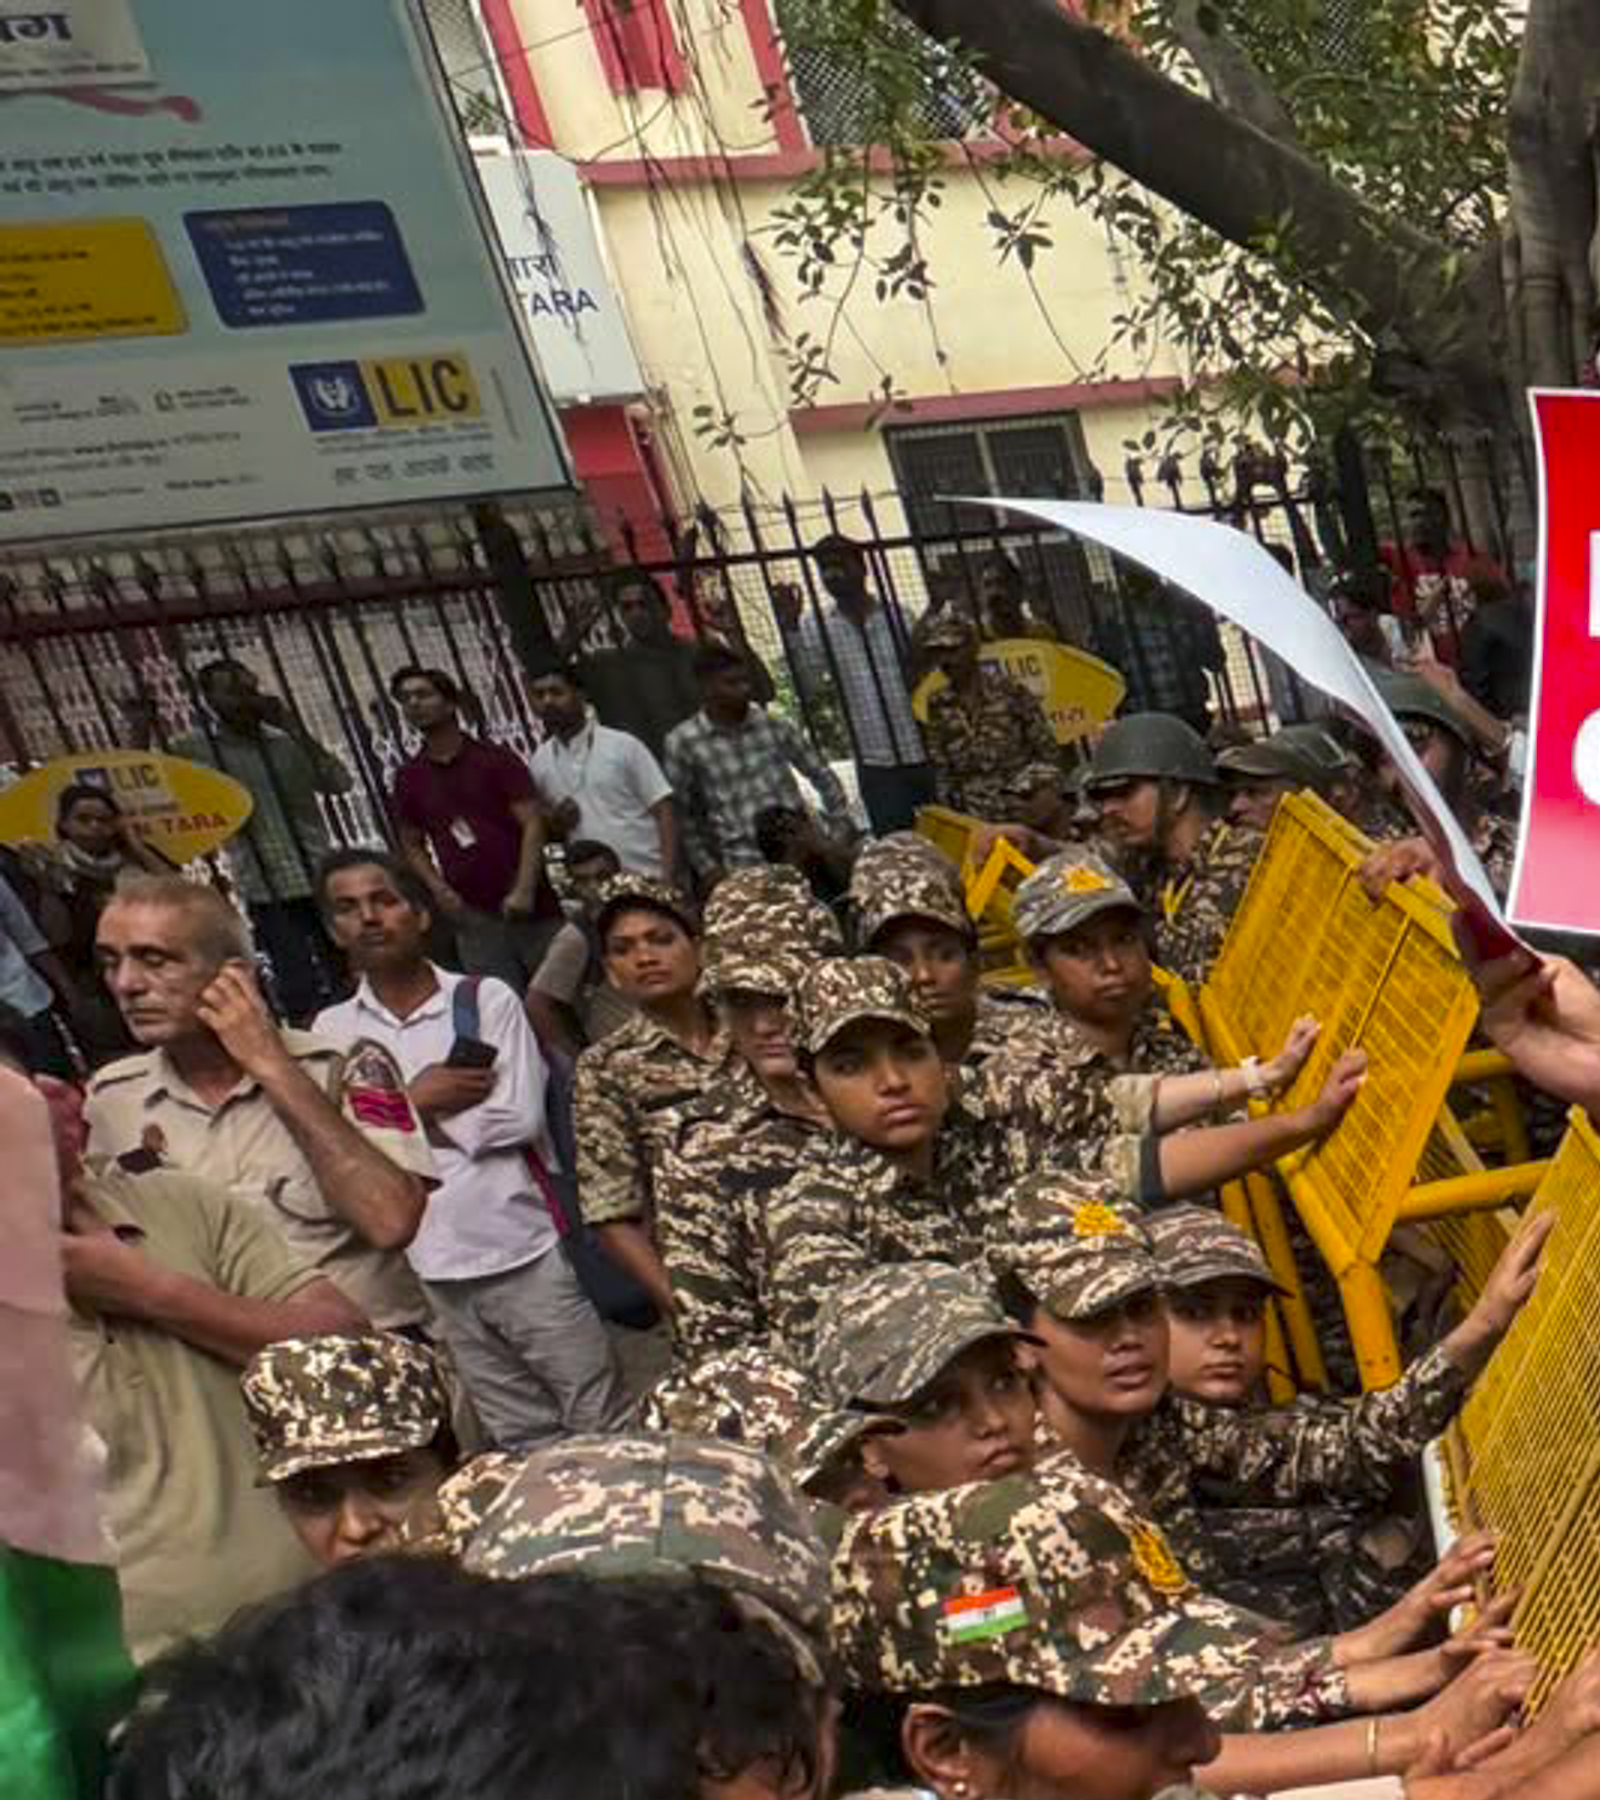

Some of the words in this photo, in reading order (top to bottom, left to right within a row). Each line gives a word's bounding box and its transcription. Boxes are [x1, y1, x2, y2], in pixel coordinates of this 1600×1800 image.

[517, 287, 601, 317] ARA
[375, 359, 469, 417] LIC
[114, 764, 160, 790] LIC
